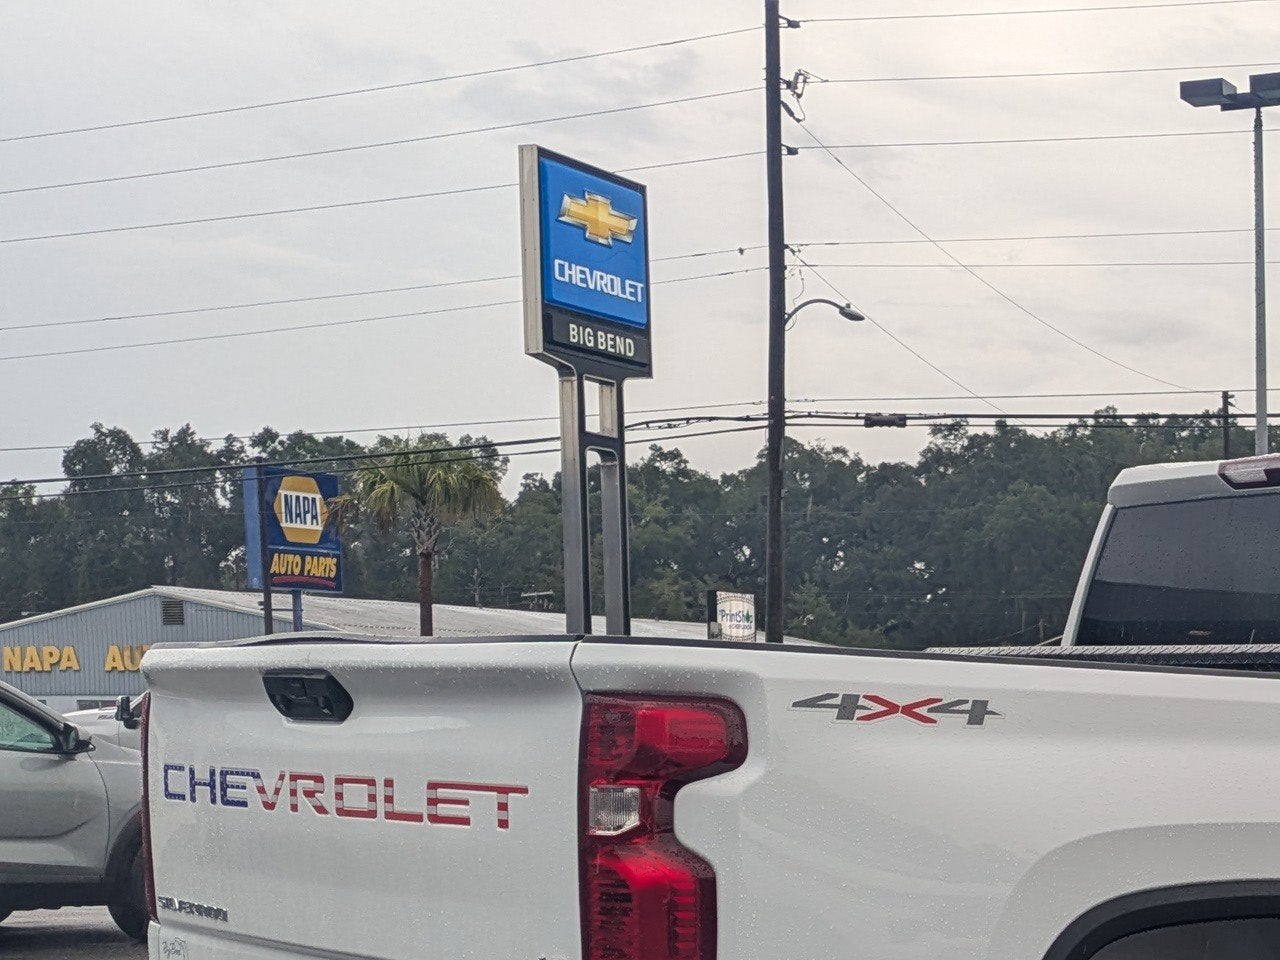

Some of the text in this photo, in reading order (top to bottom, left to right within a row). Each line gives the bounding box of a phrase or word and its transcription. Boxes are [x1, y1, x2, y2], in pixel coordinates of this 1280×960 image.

[554, 259, 644, 303] CHEVROLET
[569, 323, 635, 357] BIG BEND
[283, 493, 320, 526] NAPA
[270, 553, 337, 578] AUTO PARTS
[721, 609, 753, 623] PrintShp
[3, 645, 80, 672] NAPA
[163, 764, 530, 830] CHEVROLET
